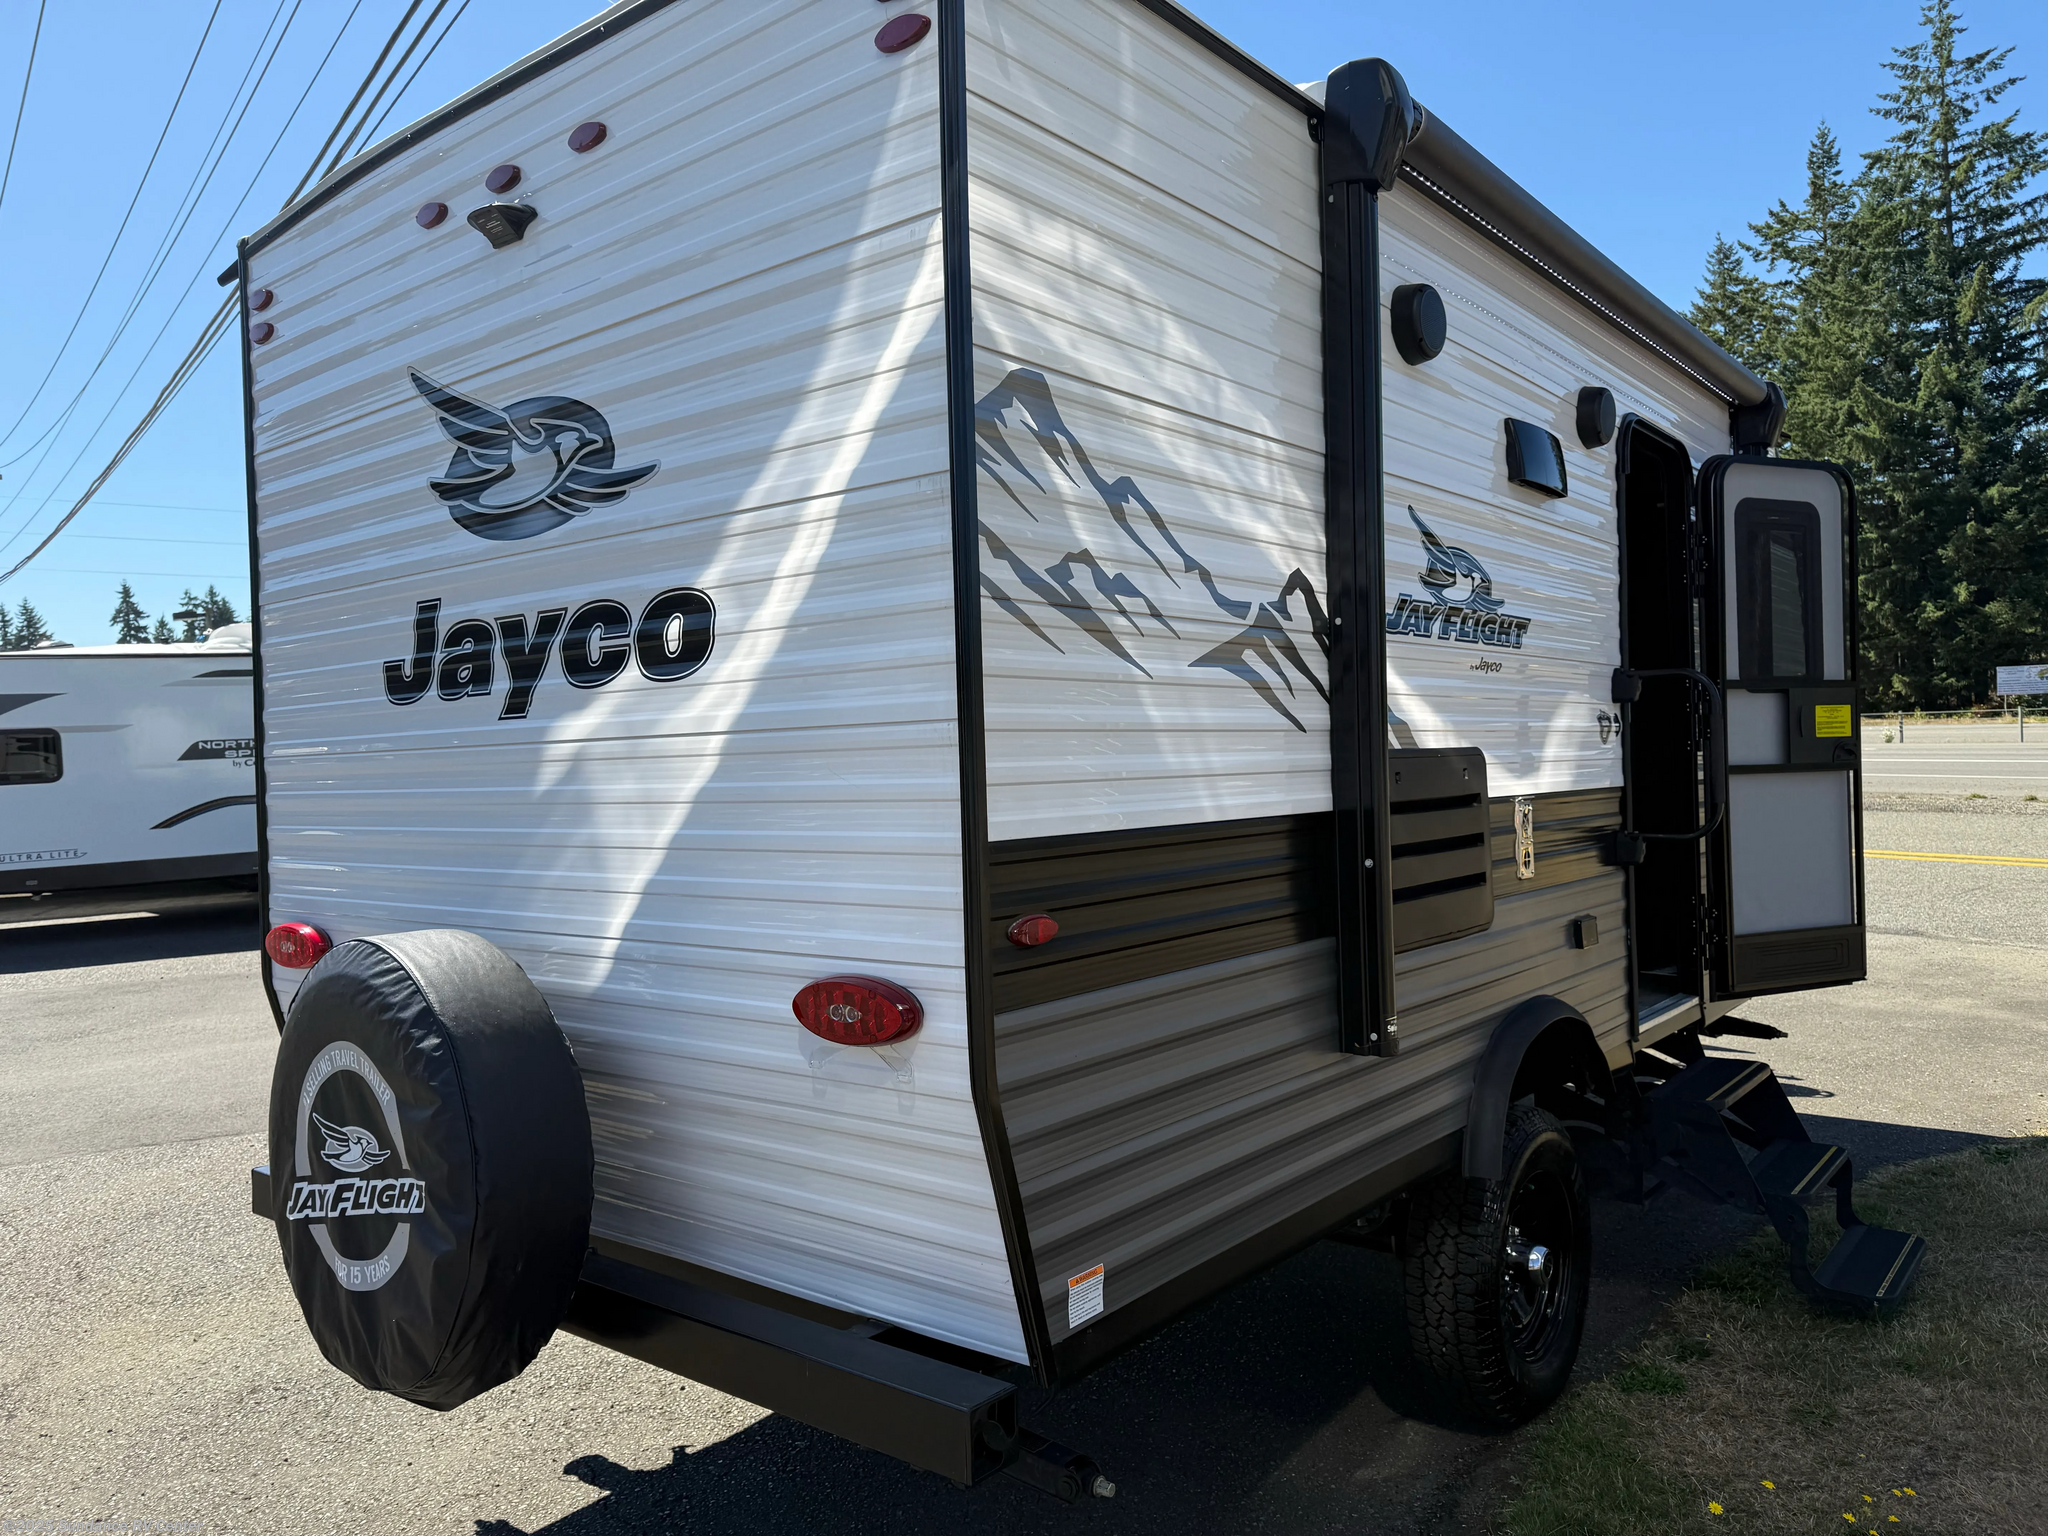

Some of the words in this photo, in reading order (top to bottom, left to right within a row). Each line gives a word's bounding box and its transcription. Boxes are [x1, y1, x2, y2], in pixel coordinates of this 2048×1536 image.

[383, 586, 716, 721] Jayco
[1475, 656, 1502, 674] Jayco
[233, 760, 242, 768] by
[50, 850, 79, 859] LITE
[306, 1055, 332, 1097] SELLING
[331, 1049, 360, 1069] TRAVEL
[360, 1056, 391, 1106] TRAILER
[335, 1255, 348, 1282] FOR
[350, 1266, 361, 1284] 15
[364, 1254, 391, 1283] YEARS
